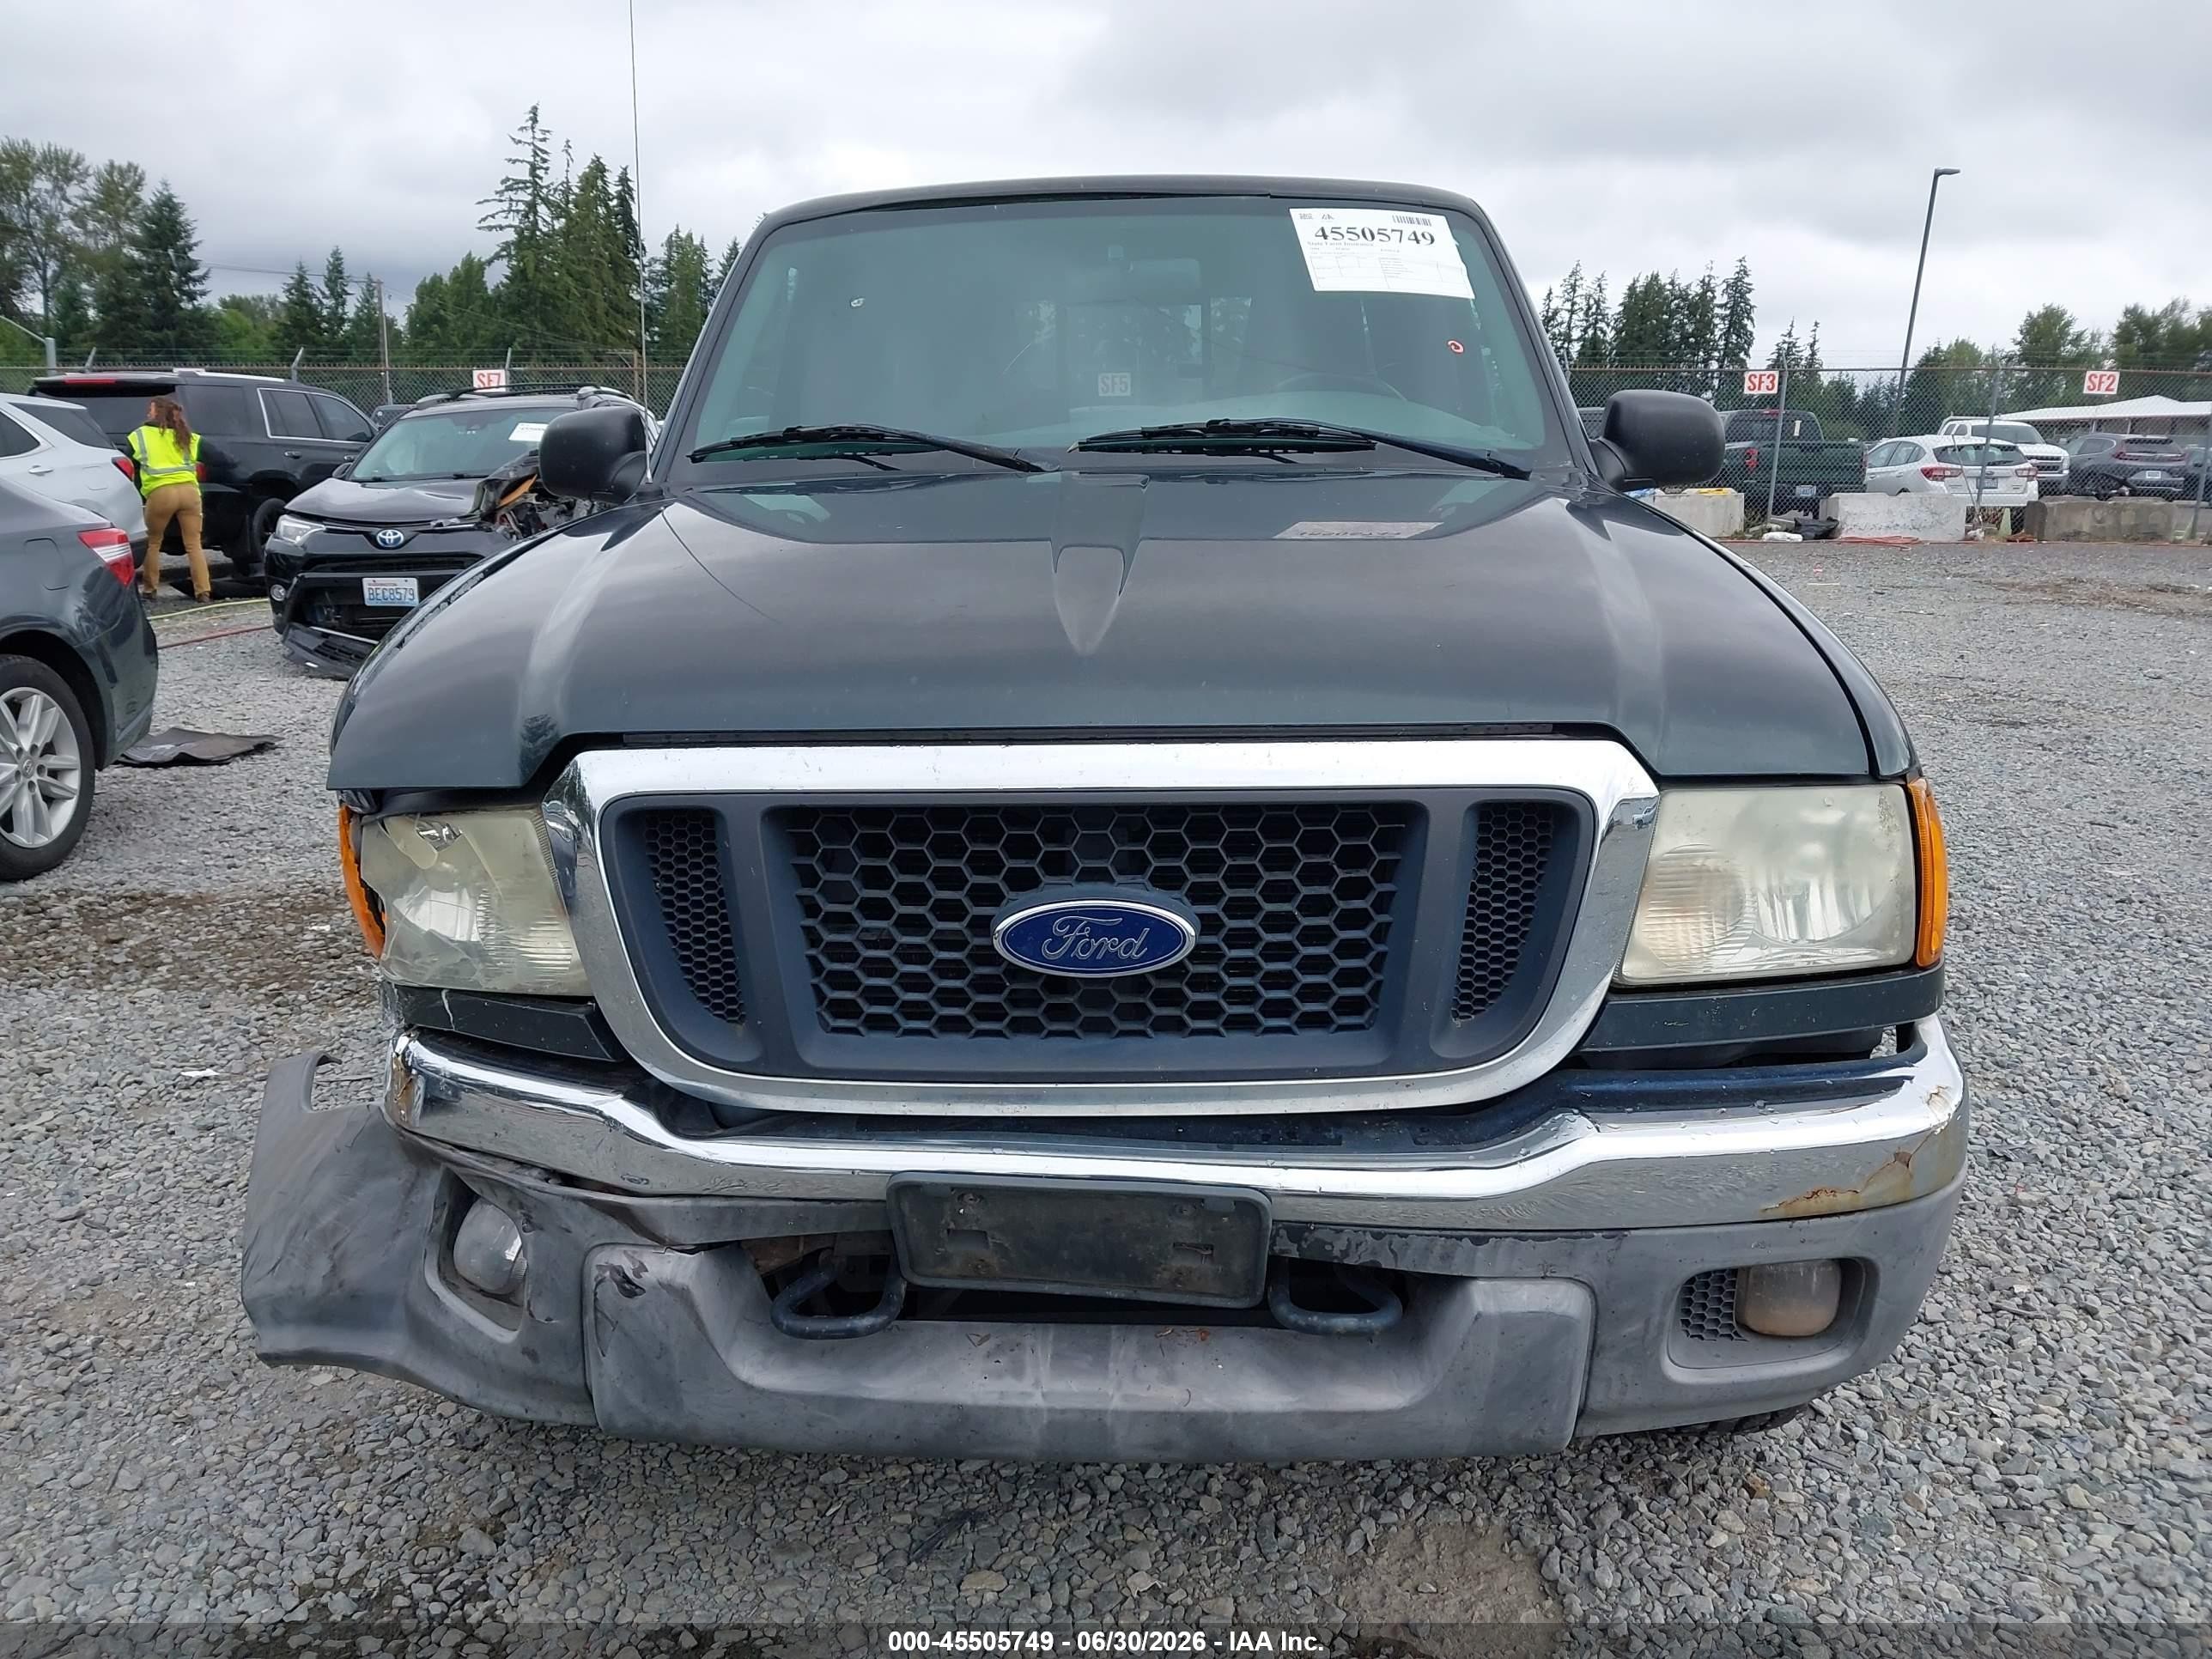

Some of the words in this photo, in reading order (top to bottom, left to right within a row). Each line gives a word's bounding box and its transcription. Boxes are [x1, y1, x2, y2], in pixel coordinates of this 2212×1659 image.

[1315, 226, 1435, 246] 45505749
[1100, 375, 1129, 394] SF5
[1747, 374, 1776, 391] SF3
[2087, 374, 2117, 392] SF2
[368, 587, 415, 600] BEC8579
[1042, 915, 1150, 960] Ford
